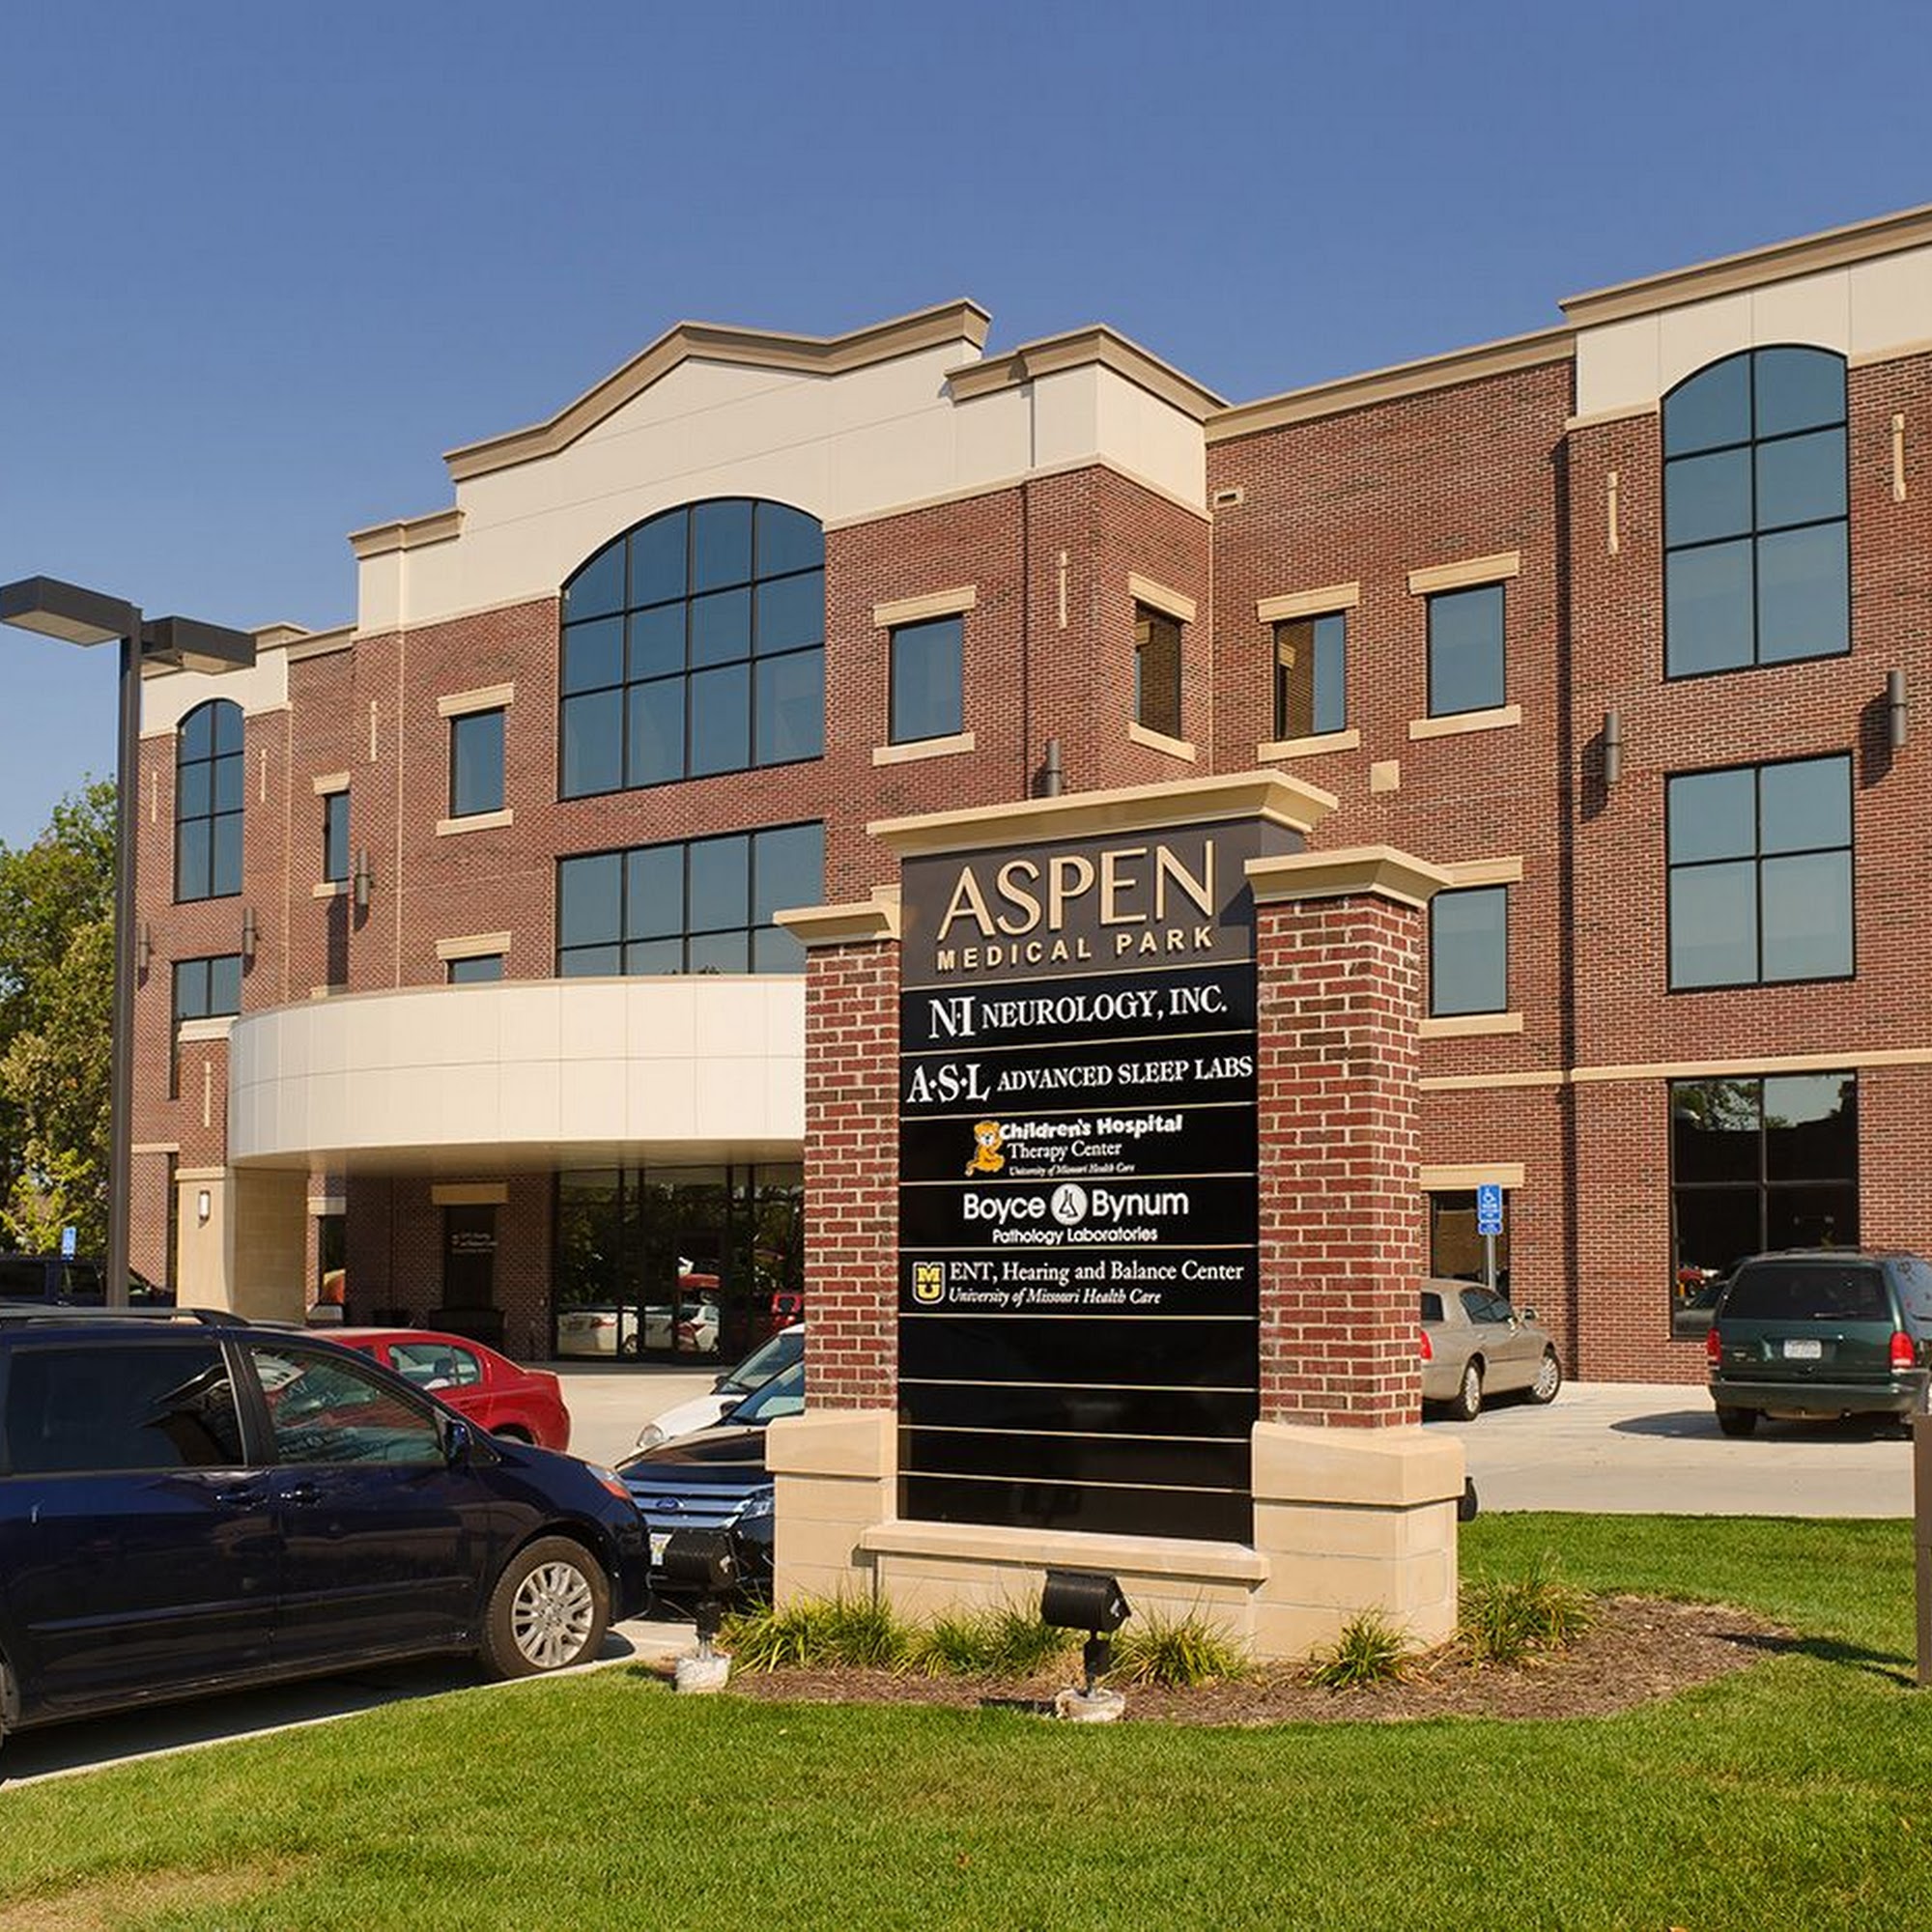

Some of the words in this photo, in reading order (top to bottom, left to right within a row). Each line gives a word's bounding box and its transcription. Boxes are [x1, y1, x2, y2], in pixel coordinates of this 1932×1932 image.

[937, 840, 1214, 940] ASPEN
[937, 937, 1092, 971] MEDICAL
[1116, 925, 1213, 955] PARK
[981, 989, 1164, 1030] NEUROLOGY,
[1169, 984, 1228, 1016] INC.
[997, 1065, 1113, 1092] ADVANCED
[1118, 1060, 1189, 1085] SLEEP
[1194, 1056, 1254, 1080] LABS
[999, 1119, 1092, 1140] Children's
[1096, 1114, 1183, 1140] Hospital
[1007, 1143, 1068, 1162] Therapy
[1071, 1140, 1122, 1157] Center
[1009, 1165, 1045, 1178] University
[963, 1193, 1046, 1225] Boyce
[1092, 1189, 1189, 1223] Bynum
[992, 1228, 1064, 1245] Pathology
[1066, 1226, 1158, 1243] Laboratories
[949, 1261, 999, 1285] ENT,
[1002, 1262, 1070, 1287] Hearing
[1074, 1260, 1106, 1281] and
[1111, 1260, 1178, 1281] Balance
[1180, 1259, 1245, 1282] Center
[949, 1287, 1010, 1308] University
[1010, 1288, 1027, 1308] of
[1026, 1289, 1081, 1304] Missouri
[1082, 1288, 1126, 1304] Health
[1128, 1288, 1162, 1304] Care
